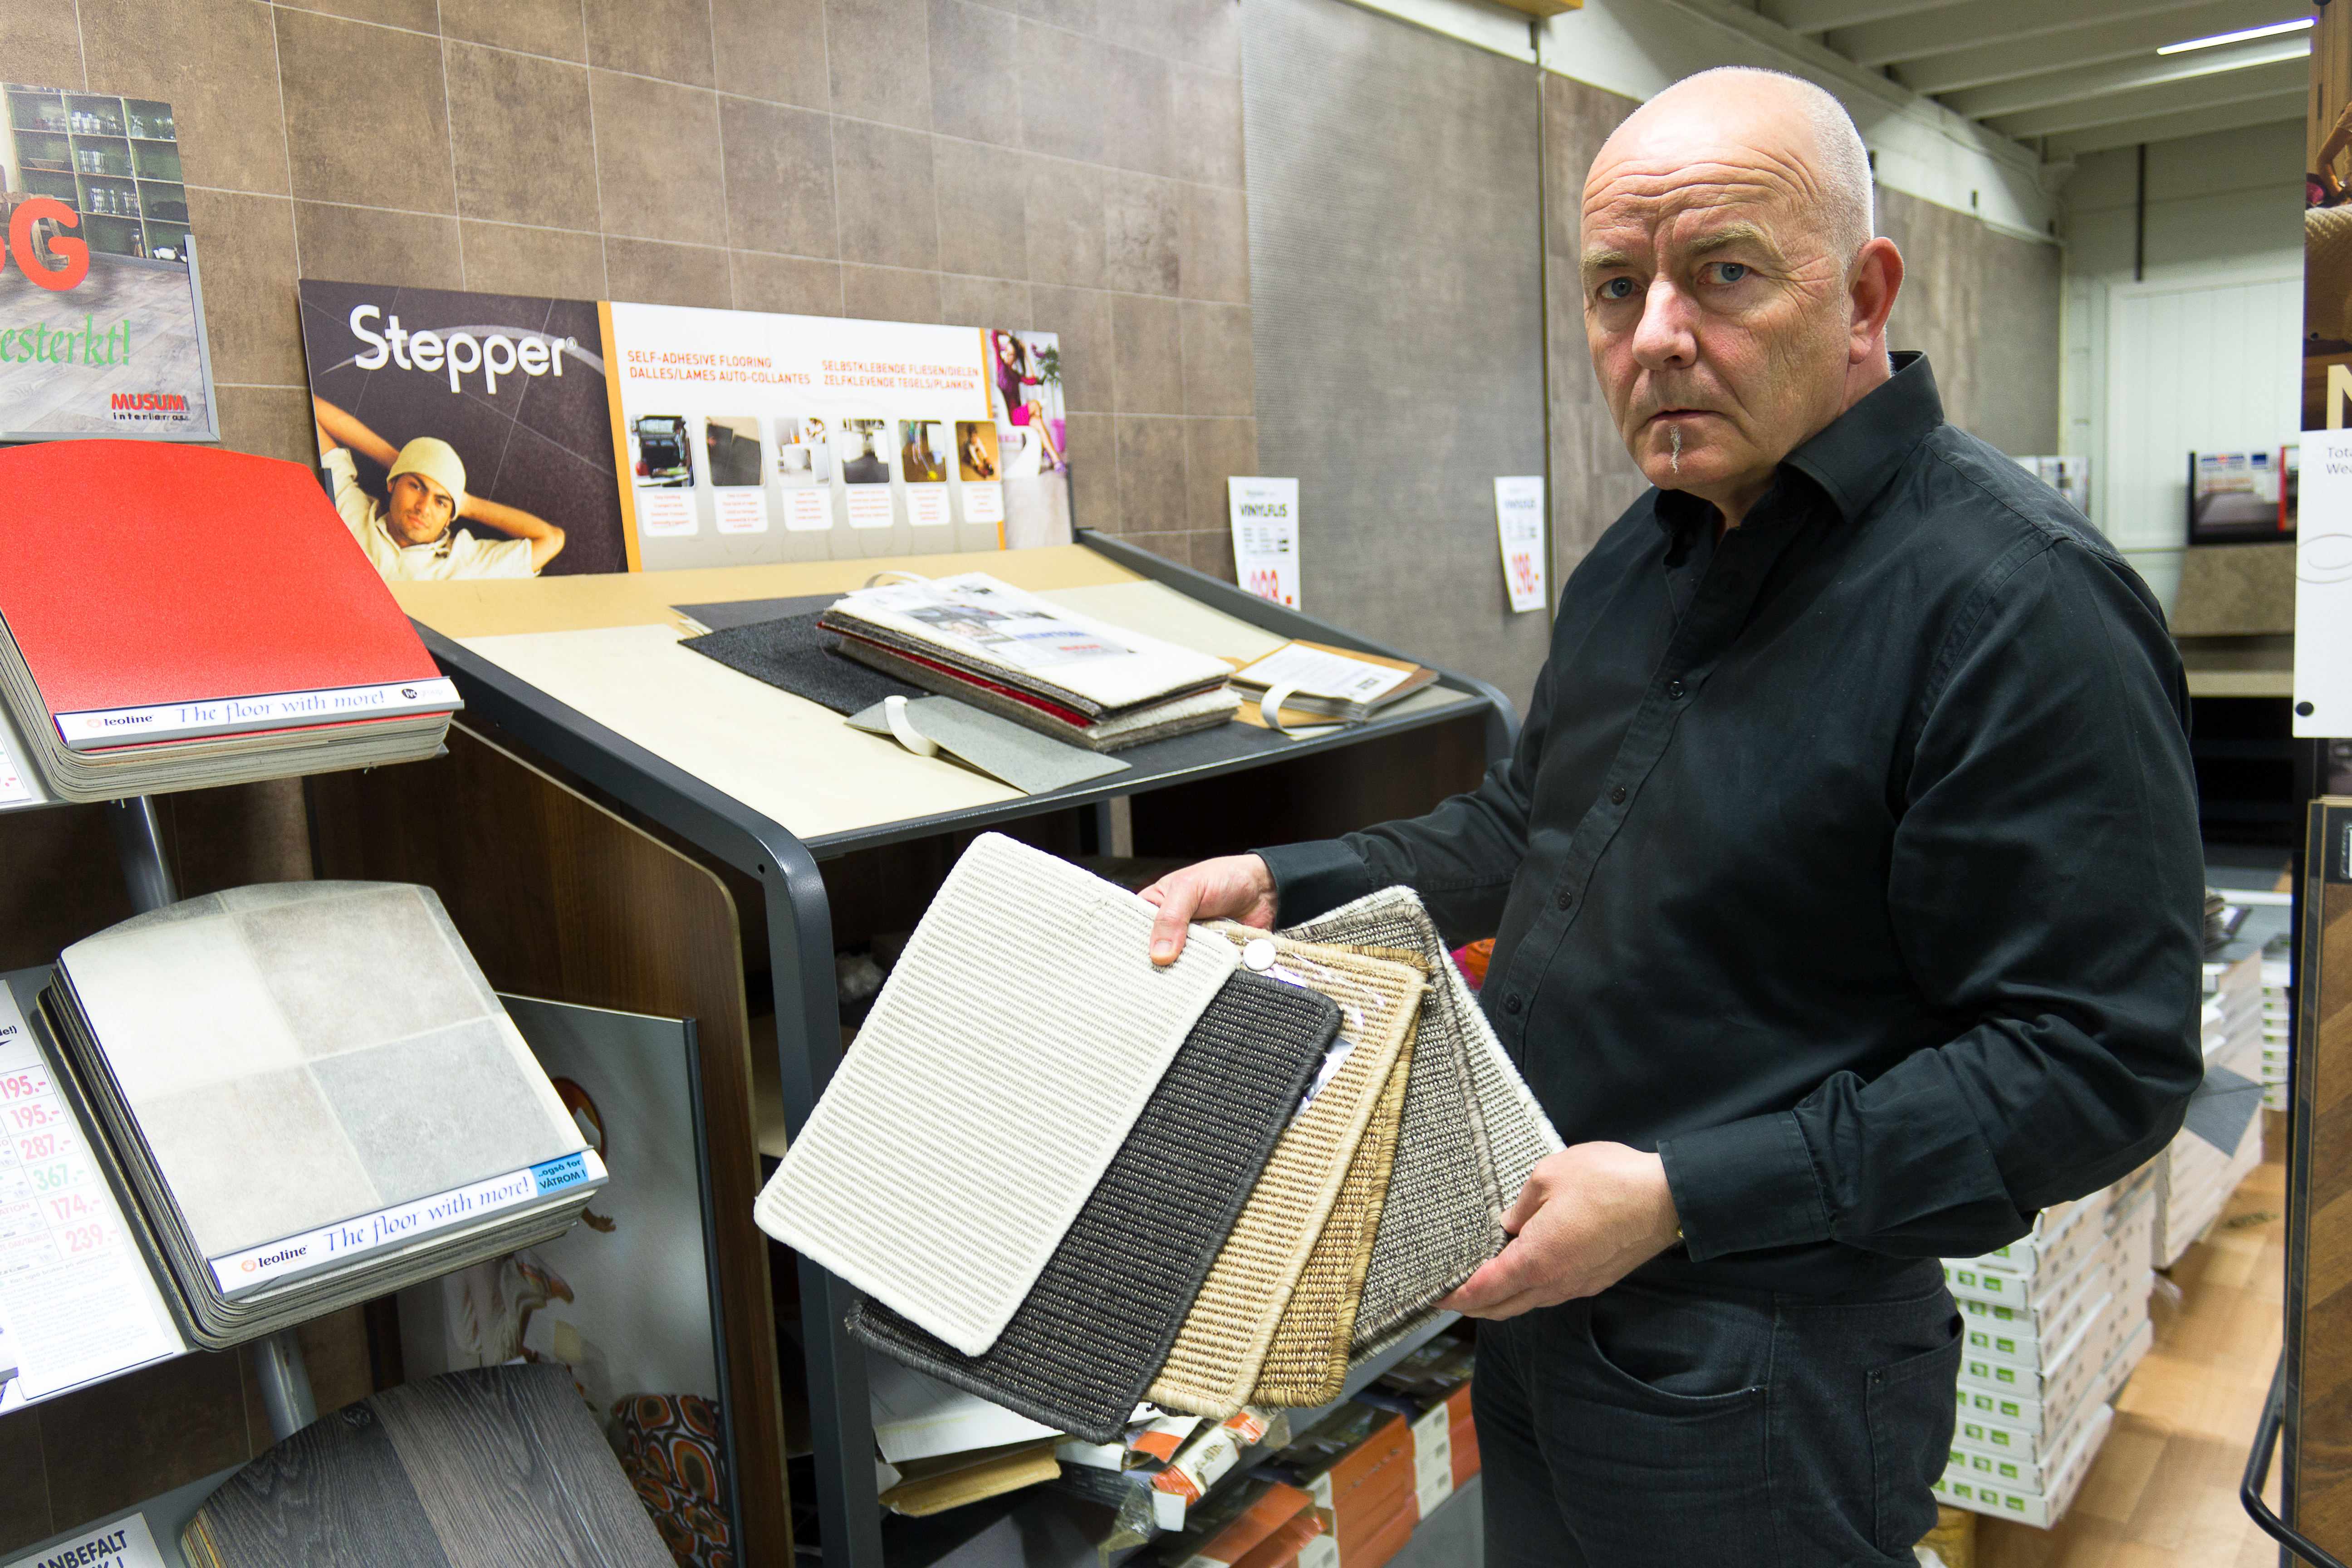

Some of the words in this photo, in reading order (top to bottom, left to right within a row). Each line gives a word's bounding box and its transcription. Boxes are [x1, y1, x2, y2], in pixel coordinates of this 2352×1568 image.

[0, 198, 89, 291] G
[0, 314, 130, 366] esterkt!
[627, 350, 716, 366] SELF-ADHESIVE
[720, 355, 772, 368] FLOORING
[630, 367, 716, 381] DALLES/LAMES
[719, 370, 810, 384] AUTO-COLLANTES
[111, 393, 185, 411] MUSUM
[175, 706, 216, 723] The
[225, 702, 274, 724] floor
[281, 695, 326, 713] with
[334, 690, 385, 708] more!
[104, 715, 152, 726] leoline
[10, 1104, 60, 1129] 195.-
[20, 1133, 71, 1160] 287.-
[566, 1160, 581, 1168] for
[33, 1163, 85, 1191] 367.-
[539, 1171, 581, 1189] VÅTROM
[50, 1194, 100, 1220] 174.-
[323, 1227, 364, 1251] The
[373, 1215, 421, 1246] floor
[428, 1193, 472, 1221] with
[480, 1176, 529, 1205] more!
[65, 1223, 118, 1252] 239.-
[258, 1246, 307, 1267] leoline
